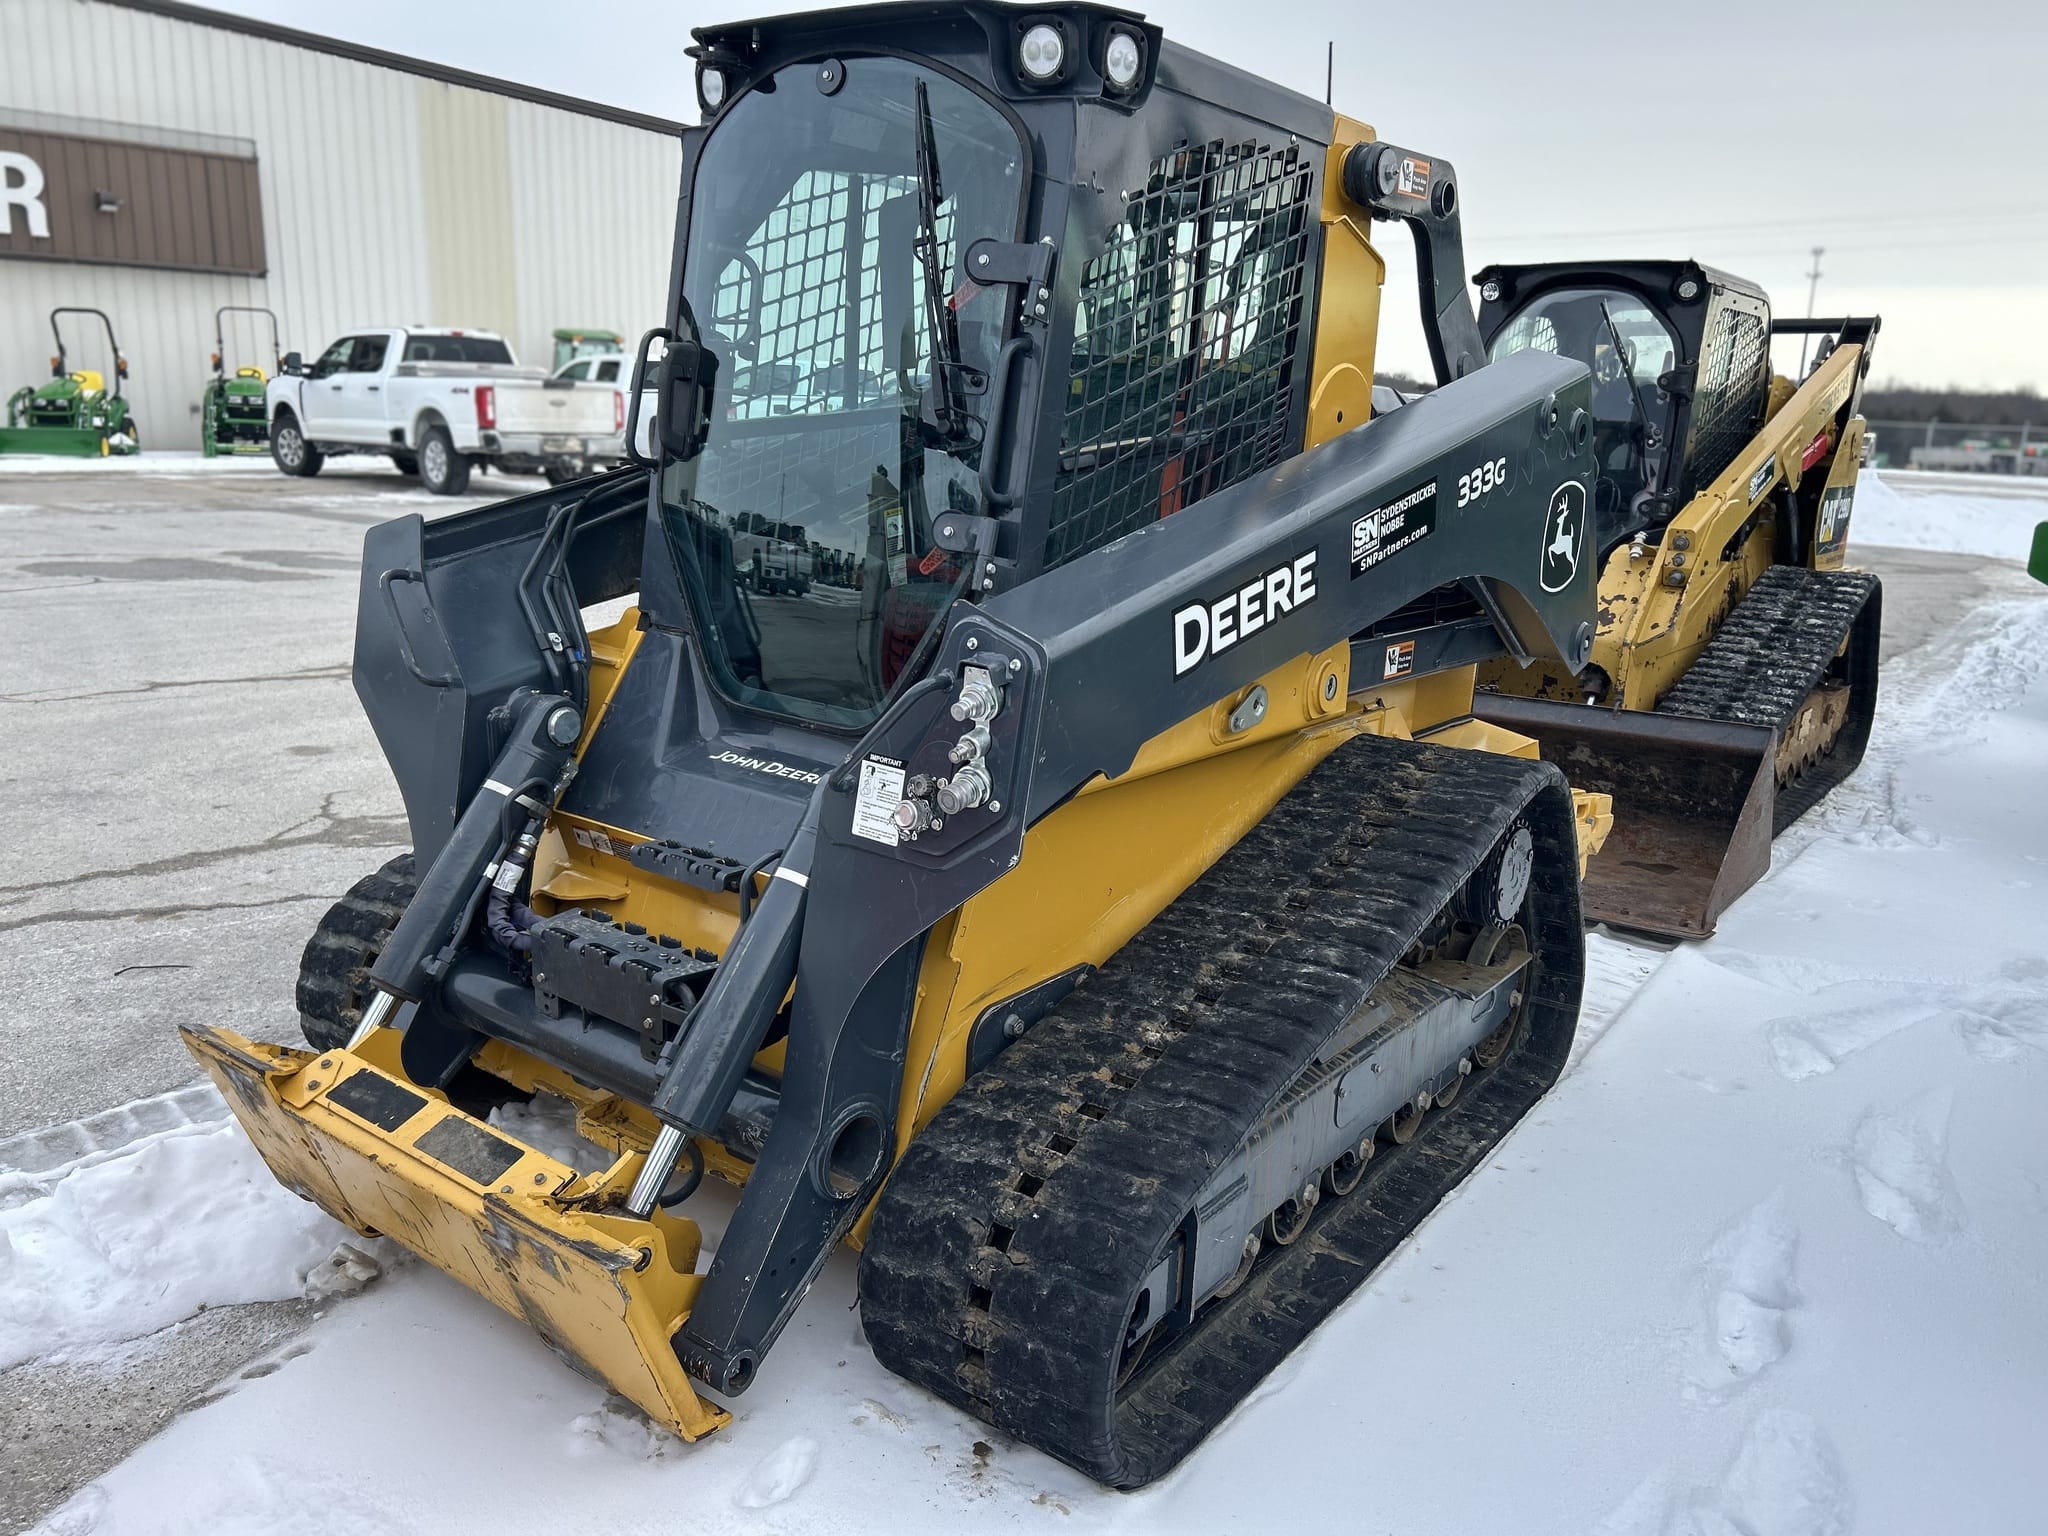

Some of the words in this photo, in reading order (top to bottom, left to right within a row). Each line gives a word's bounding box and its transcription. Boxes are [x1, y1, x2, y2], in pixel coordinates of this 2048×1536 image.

[1380, 482, 1437, 522] SYDENSTRICKER
[1457, 456, 1506, 508] 333G
[1354, 513, 1378, 548] SN
[1380, 513, 1405, 538] NOBBE
[1819, 499, 1838, 543] CAT
[1360, 524, 1428, 571] SNPartners.com
[1174, 550, 1317, 676] DEERE
[709, 750, 766, 770] JOHN
[869, 753, 903, 768] IMPORTANT
